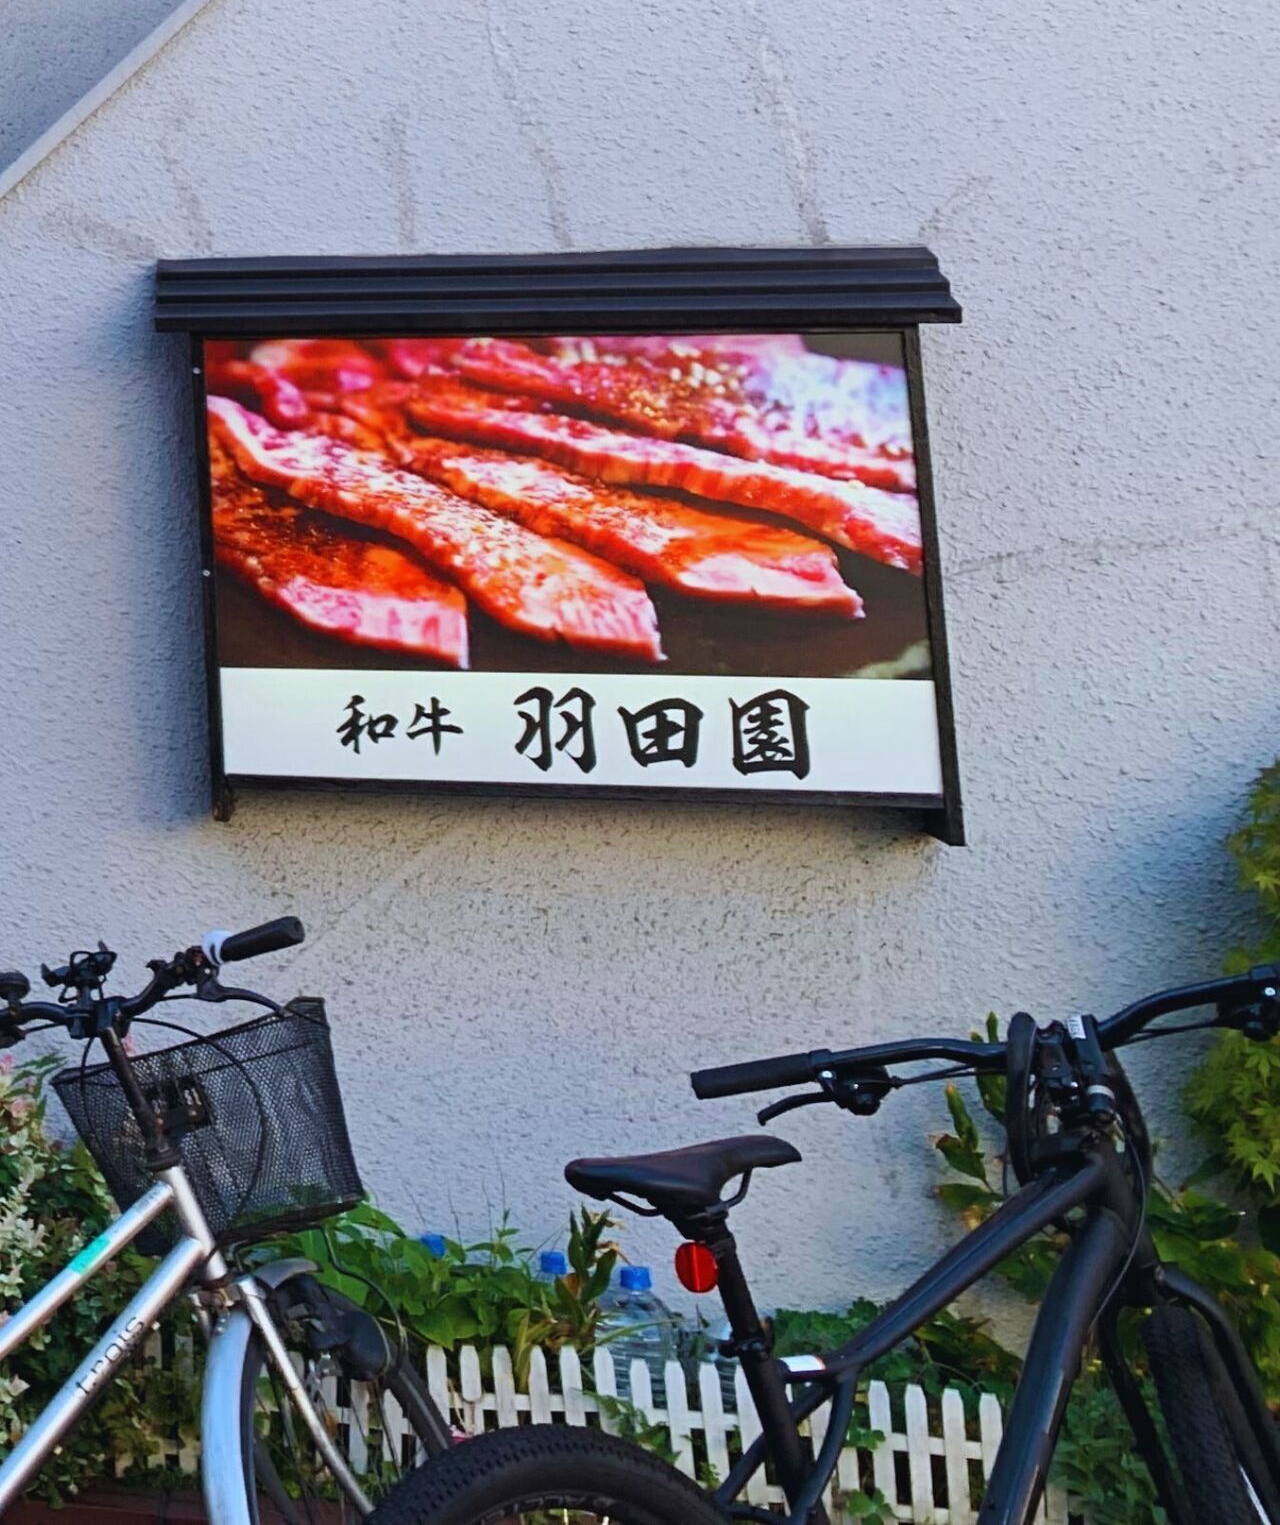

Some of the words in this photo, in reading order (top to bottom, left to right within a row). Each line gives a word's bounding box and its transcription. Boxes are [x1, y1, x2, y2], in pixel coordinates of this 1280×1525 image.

[335, 694, 463, 755] 和牛
[514, 686, 811, 780] 羽田園
